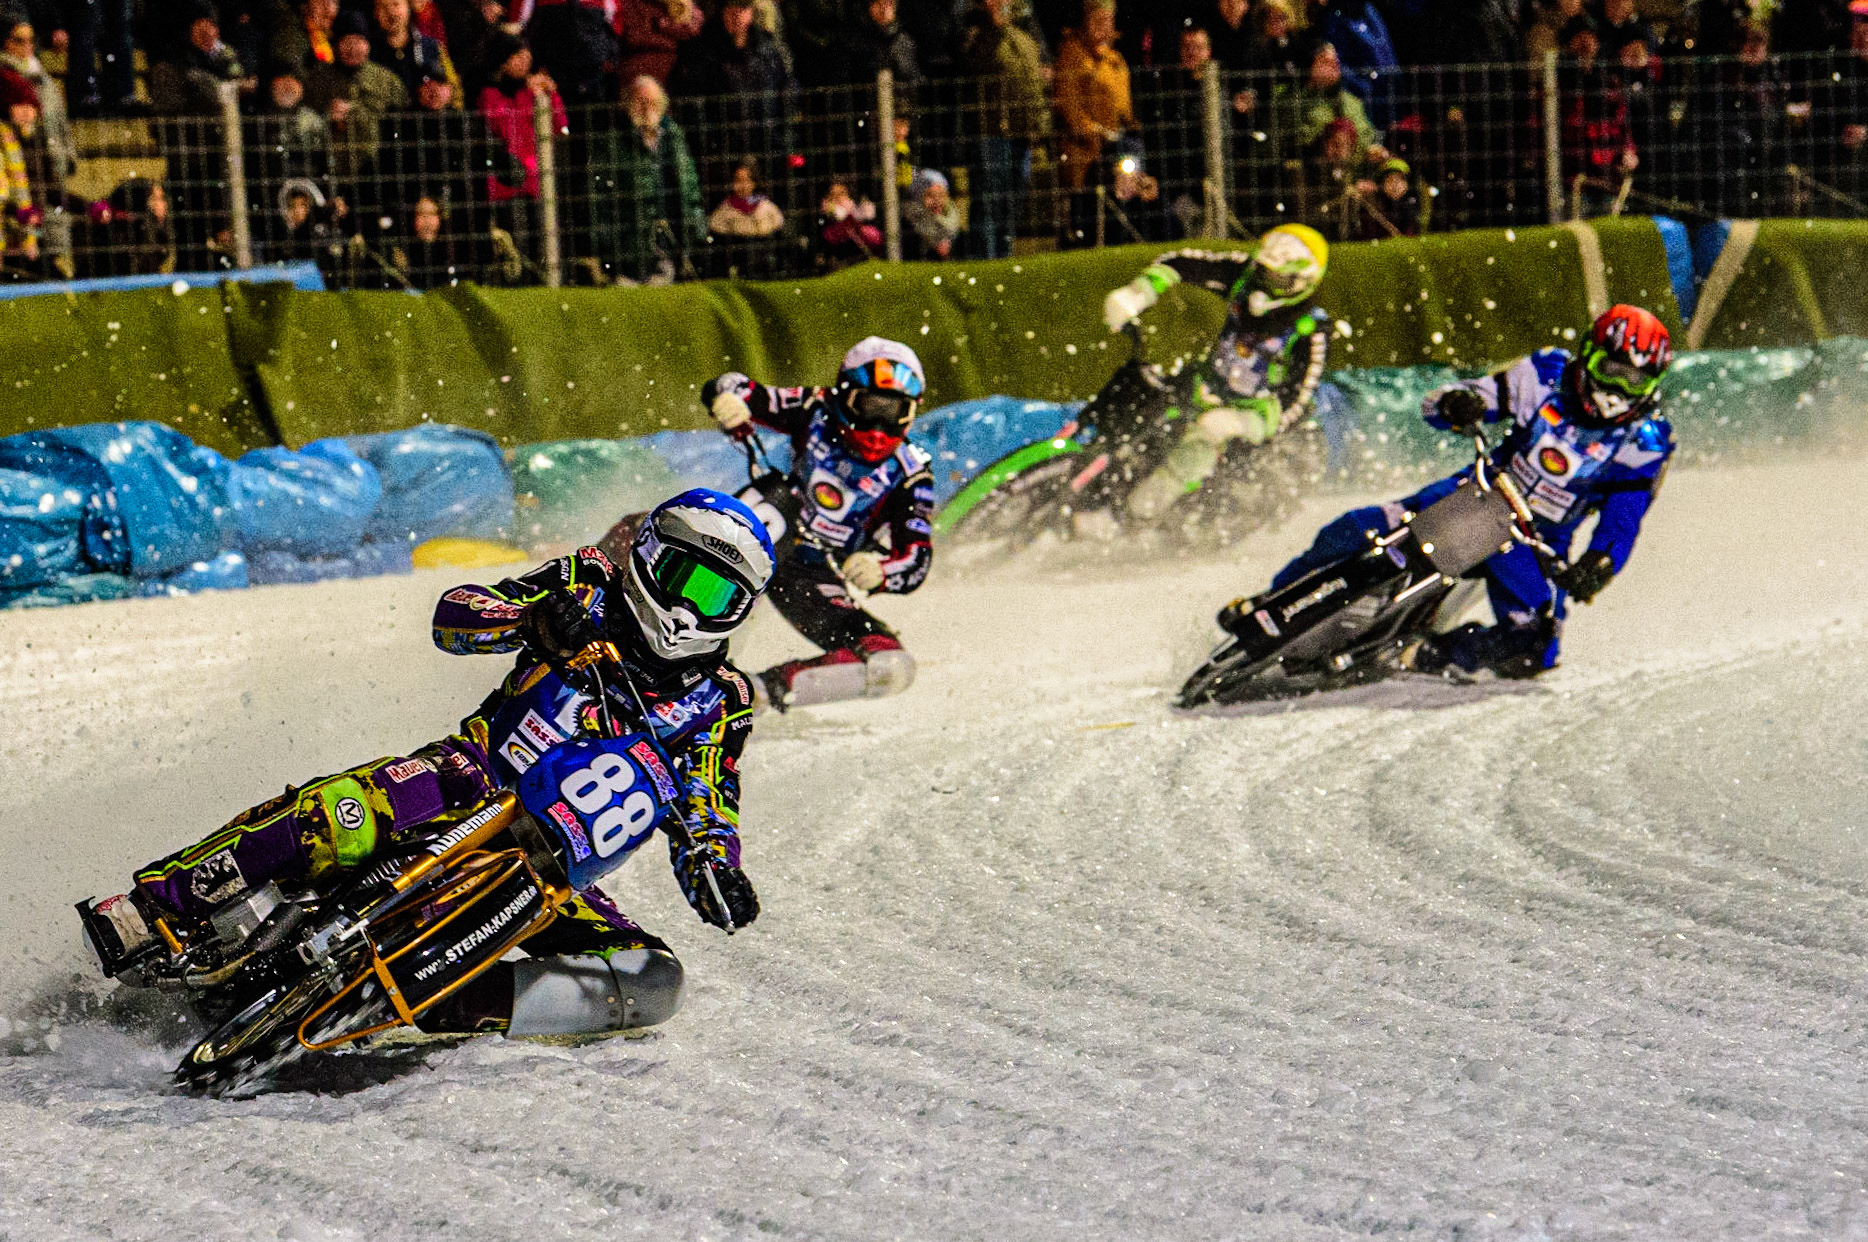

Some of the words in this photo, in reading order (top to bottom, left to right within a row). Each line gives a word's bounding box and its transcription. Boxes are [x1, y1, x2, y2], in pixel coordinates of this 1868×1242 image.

[706, 538, 741, 566] SHOEI
[525, 718, 556, 747] SASS
[560, 752, 656, 859] 88
